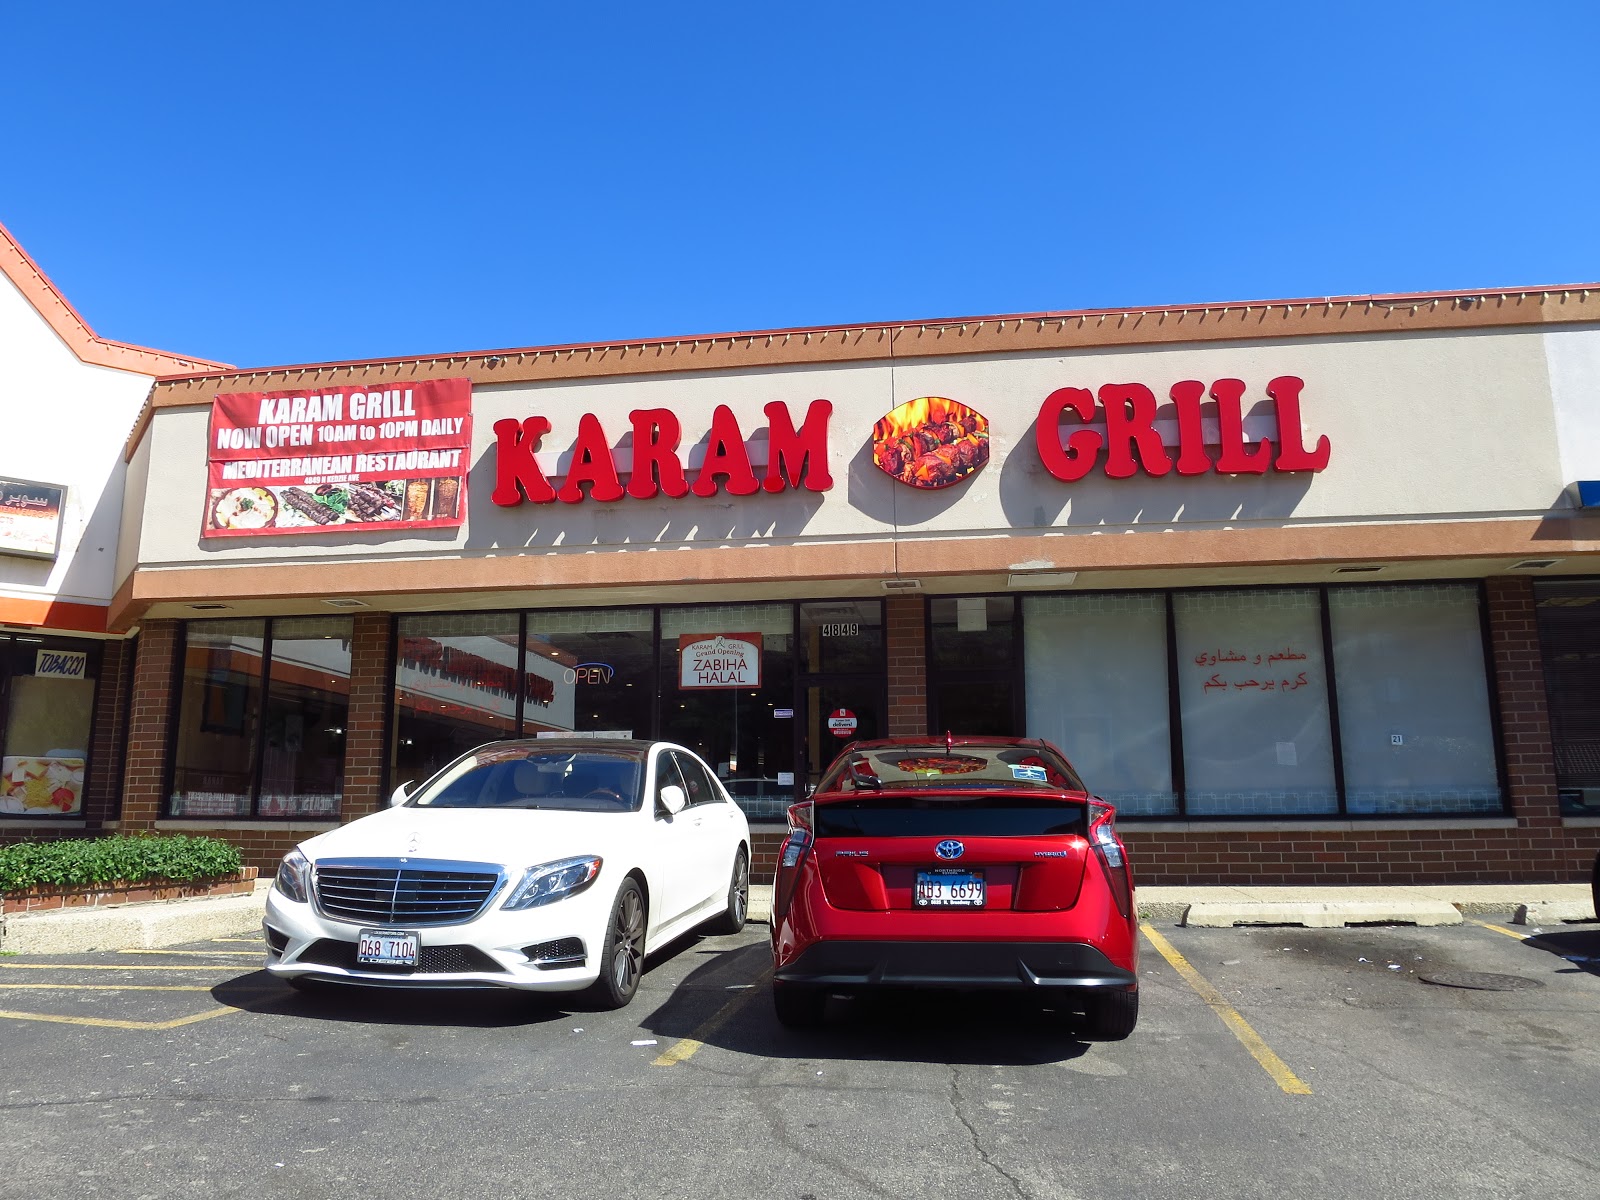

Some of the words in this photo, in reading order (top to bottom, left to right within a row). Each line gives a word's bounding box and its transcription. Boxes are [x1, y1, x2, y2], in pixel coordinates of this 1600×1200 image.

[258, 393, 343, 425] KARAM
[349, 389, 416, 420] GRILL
[217, 427, 262, 449] NOW
[265, 424, 314, 448] OPEN
[317, 424, 357, 443] 10AM
[360, 425, 376, 441] to
[379, 421, 418, 440] 10PM
[421, 417, 464, 436] DAILY
[491, 399, 833, 507] KARAM
[1036, 376, 1331, 482] GRILL
[222, 455, 353, 480] MEDITERRANEAN
[356, 449, 463, 473] RESTAURANT
[304, 476, 321, 485] 4849
[321, 476, 327, 484] N
[348, 473, 360, 482] AVE
[823, 623, 858, 636] 4849
[695, 649, 716, 658] Grand
[718, 648, 745, 659] Opening
[1195, 649, 1247, 666] مشاوي
[1253, 654, 1262, 665] و
[1268, 647, 1307, 668] مطعم
[38, 653, 85, 676] TOBACCO
[693, 659, 748, 671] ZABIHA
[564, 667, 610, 685] OPEN
[698, 671, 746, 684] HALAL
[1203, 674, 1228, 694] بكم
[1234, 679, 1274, 691] يرحب
[1281, 672, 1308, 692] كرم
[951, 880, 982, 899] 6699
[389, 941, 415, 959] 7104
